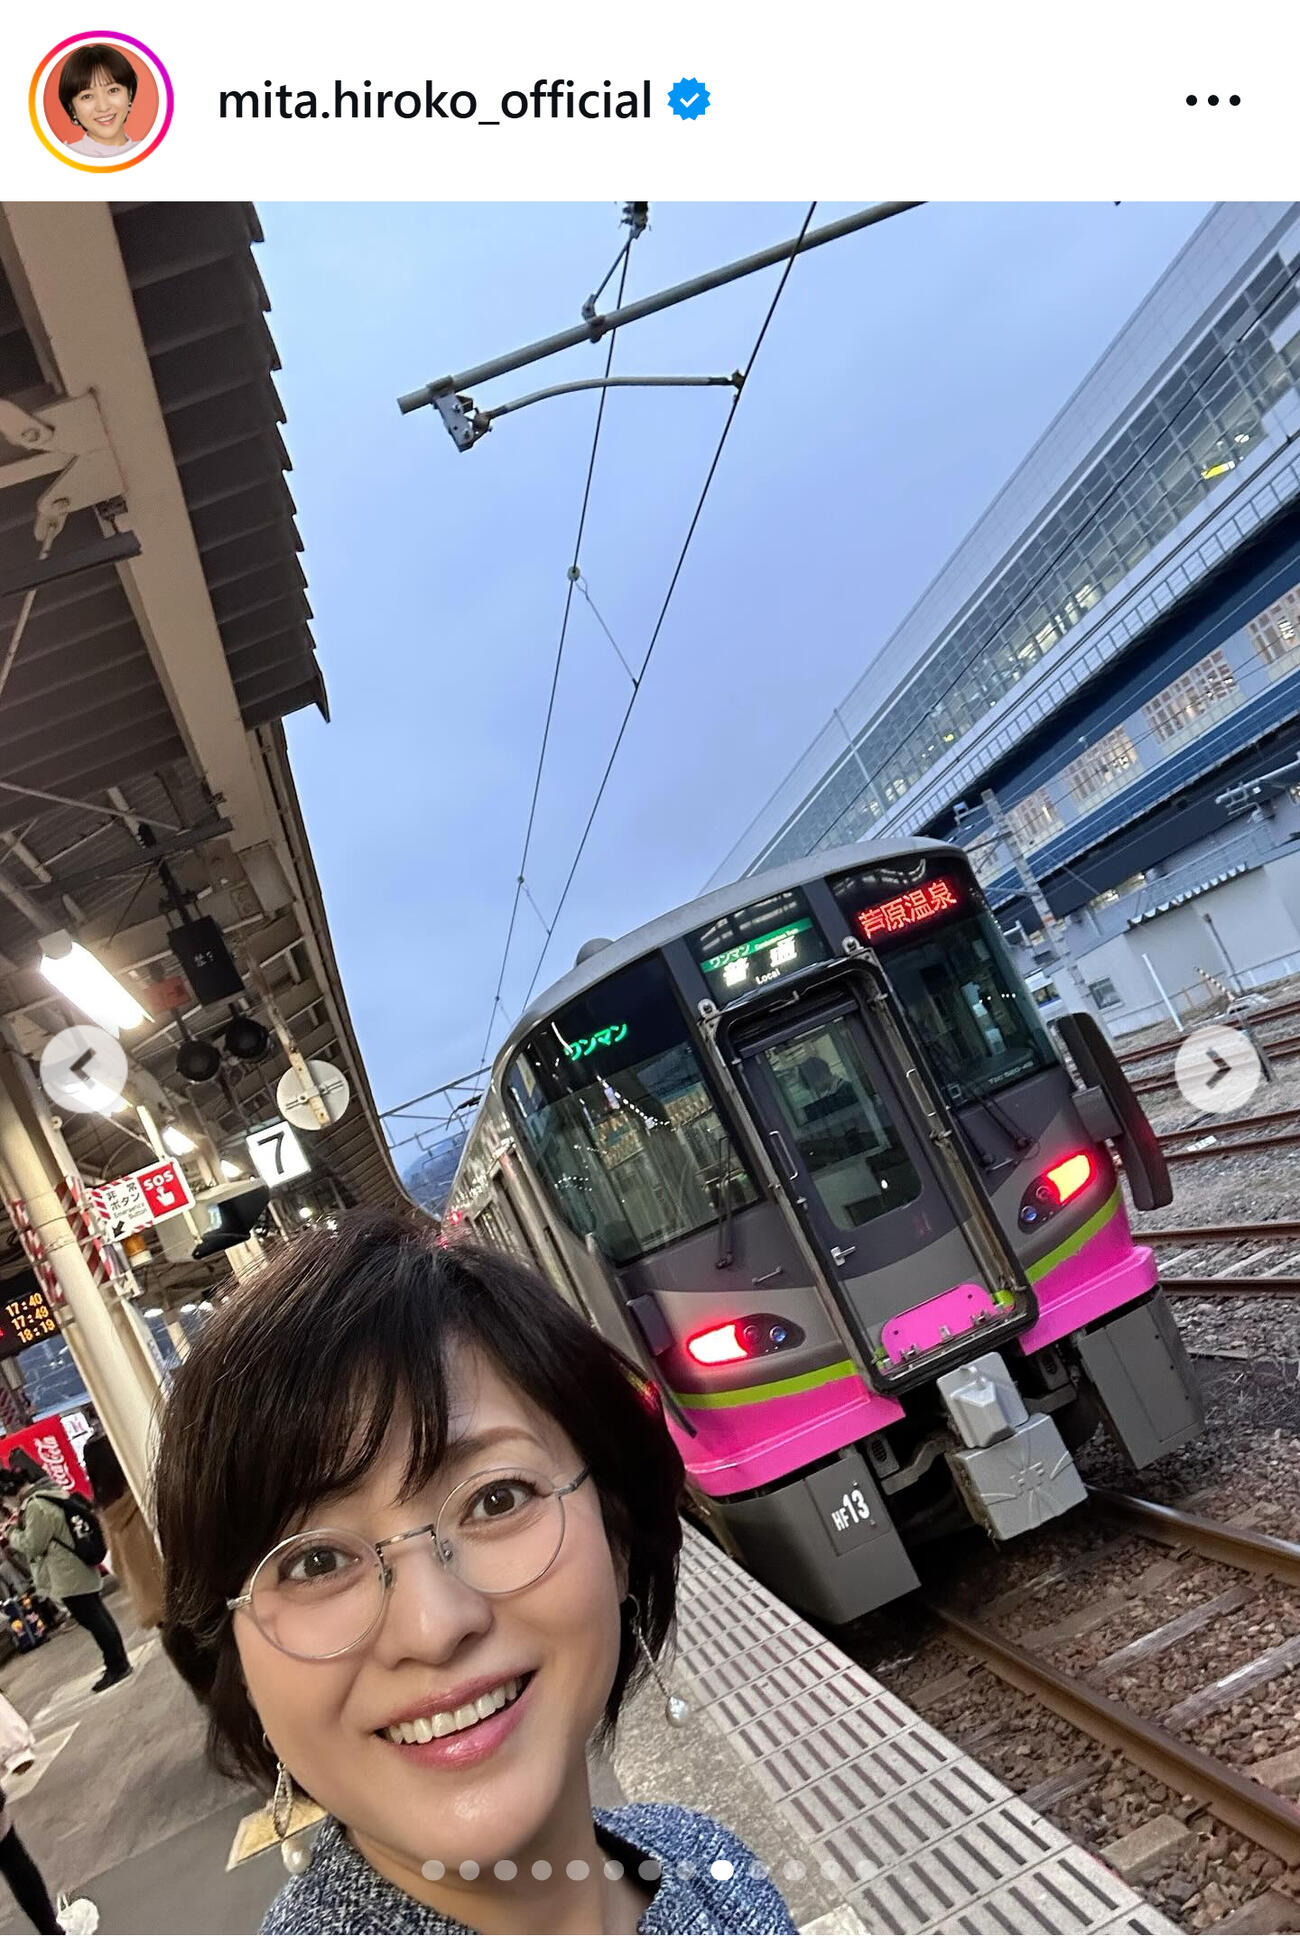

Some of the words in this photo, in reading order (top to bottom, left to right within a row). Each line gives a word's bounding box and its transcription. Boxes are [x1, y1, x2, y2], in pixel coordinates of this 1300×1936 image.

[858, 880, 957, 939] 芦原温泉
[709, 944, 750, 968] ワンマン
[755, 968, 781, 985] Local
[563, 1023, 628, 1061] ワンマン
[256, 1130, 285, 1175] 7
[143, 1170, 174, 1191] SOS
[110, 1192, 140, 1211] ボタン
[5, 1293, 43, 1317] 17:40
[17, 1319, 55, 1343] 18:19
